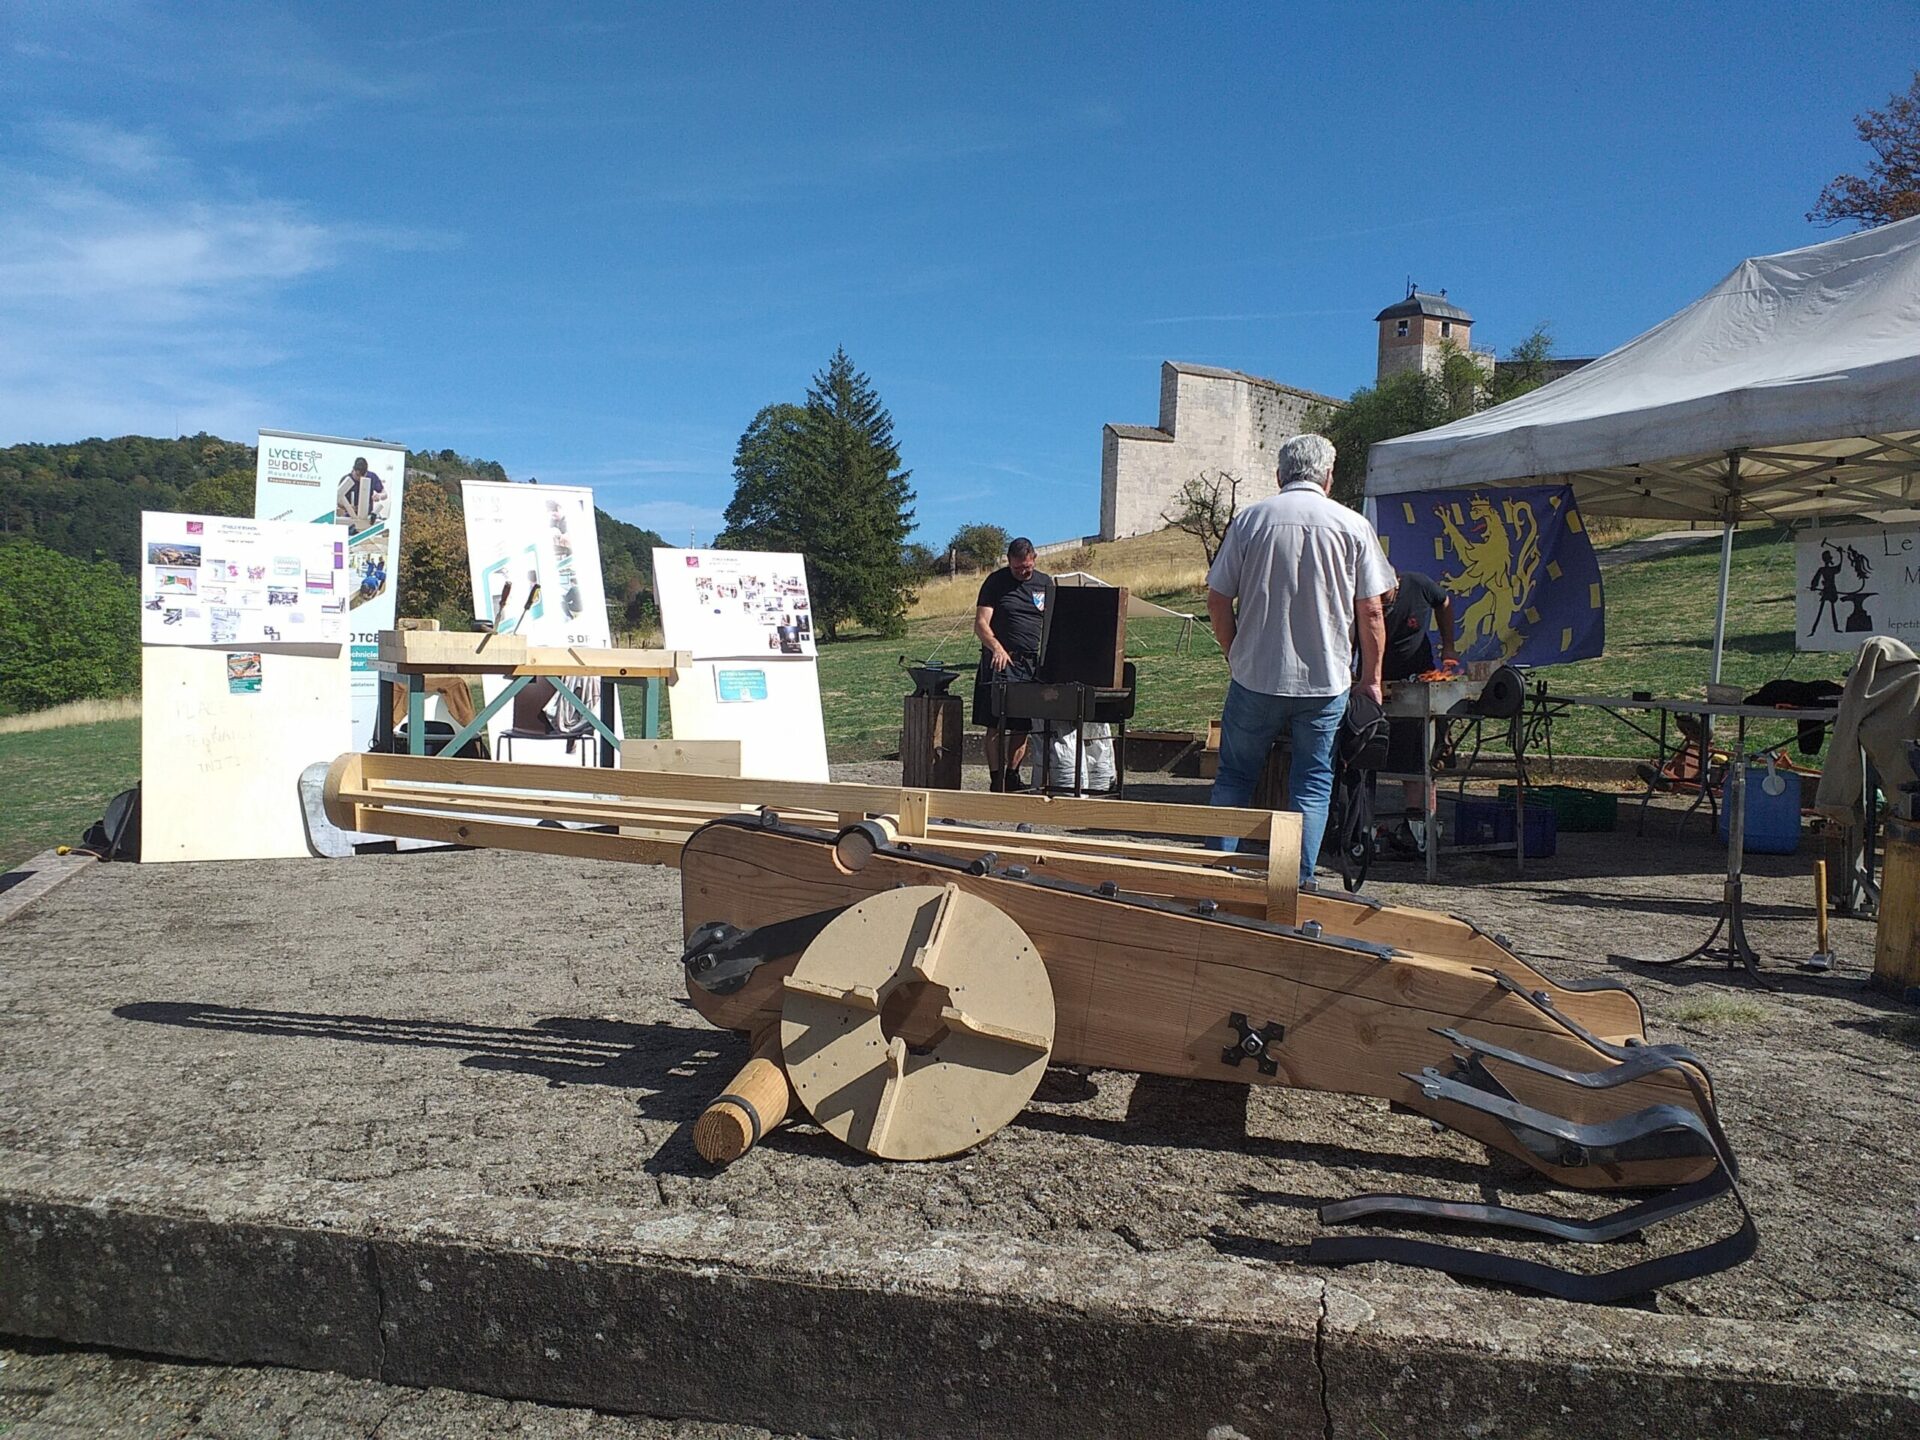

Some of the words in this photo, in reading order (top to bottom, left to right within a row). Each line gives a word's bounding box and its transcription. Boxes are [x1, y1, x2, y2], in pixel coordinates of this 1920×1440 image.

[268, 448, 303, 461] LYCÉE
[268, 459, 281, 467] DU
[282, 460, 309, 472] BOIS
[1883, 530, 1913, 556] Le
